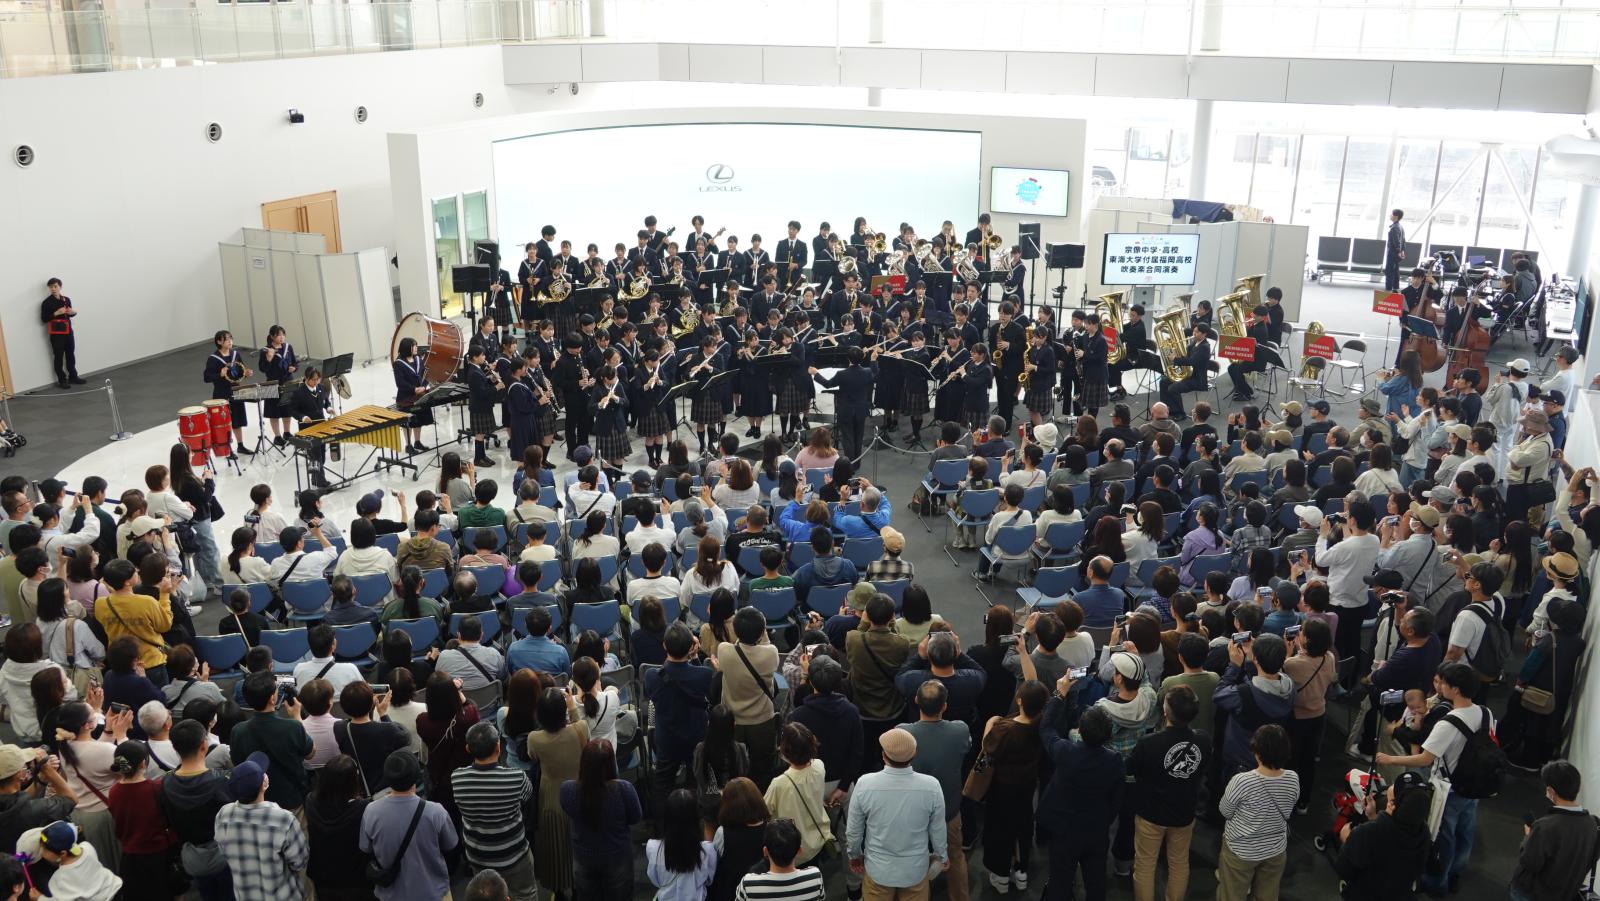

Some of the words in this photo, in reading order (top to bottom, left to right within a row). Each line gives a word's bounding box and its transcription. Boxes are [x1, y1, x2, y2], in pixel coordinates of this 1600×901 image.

[1121, 265, 1179, 274] 吹奏楽合同演奏
